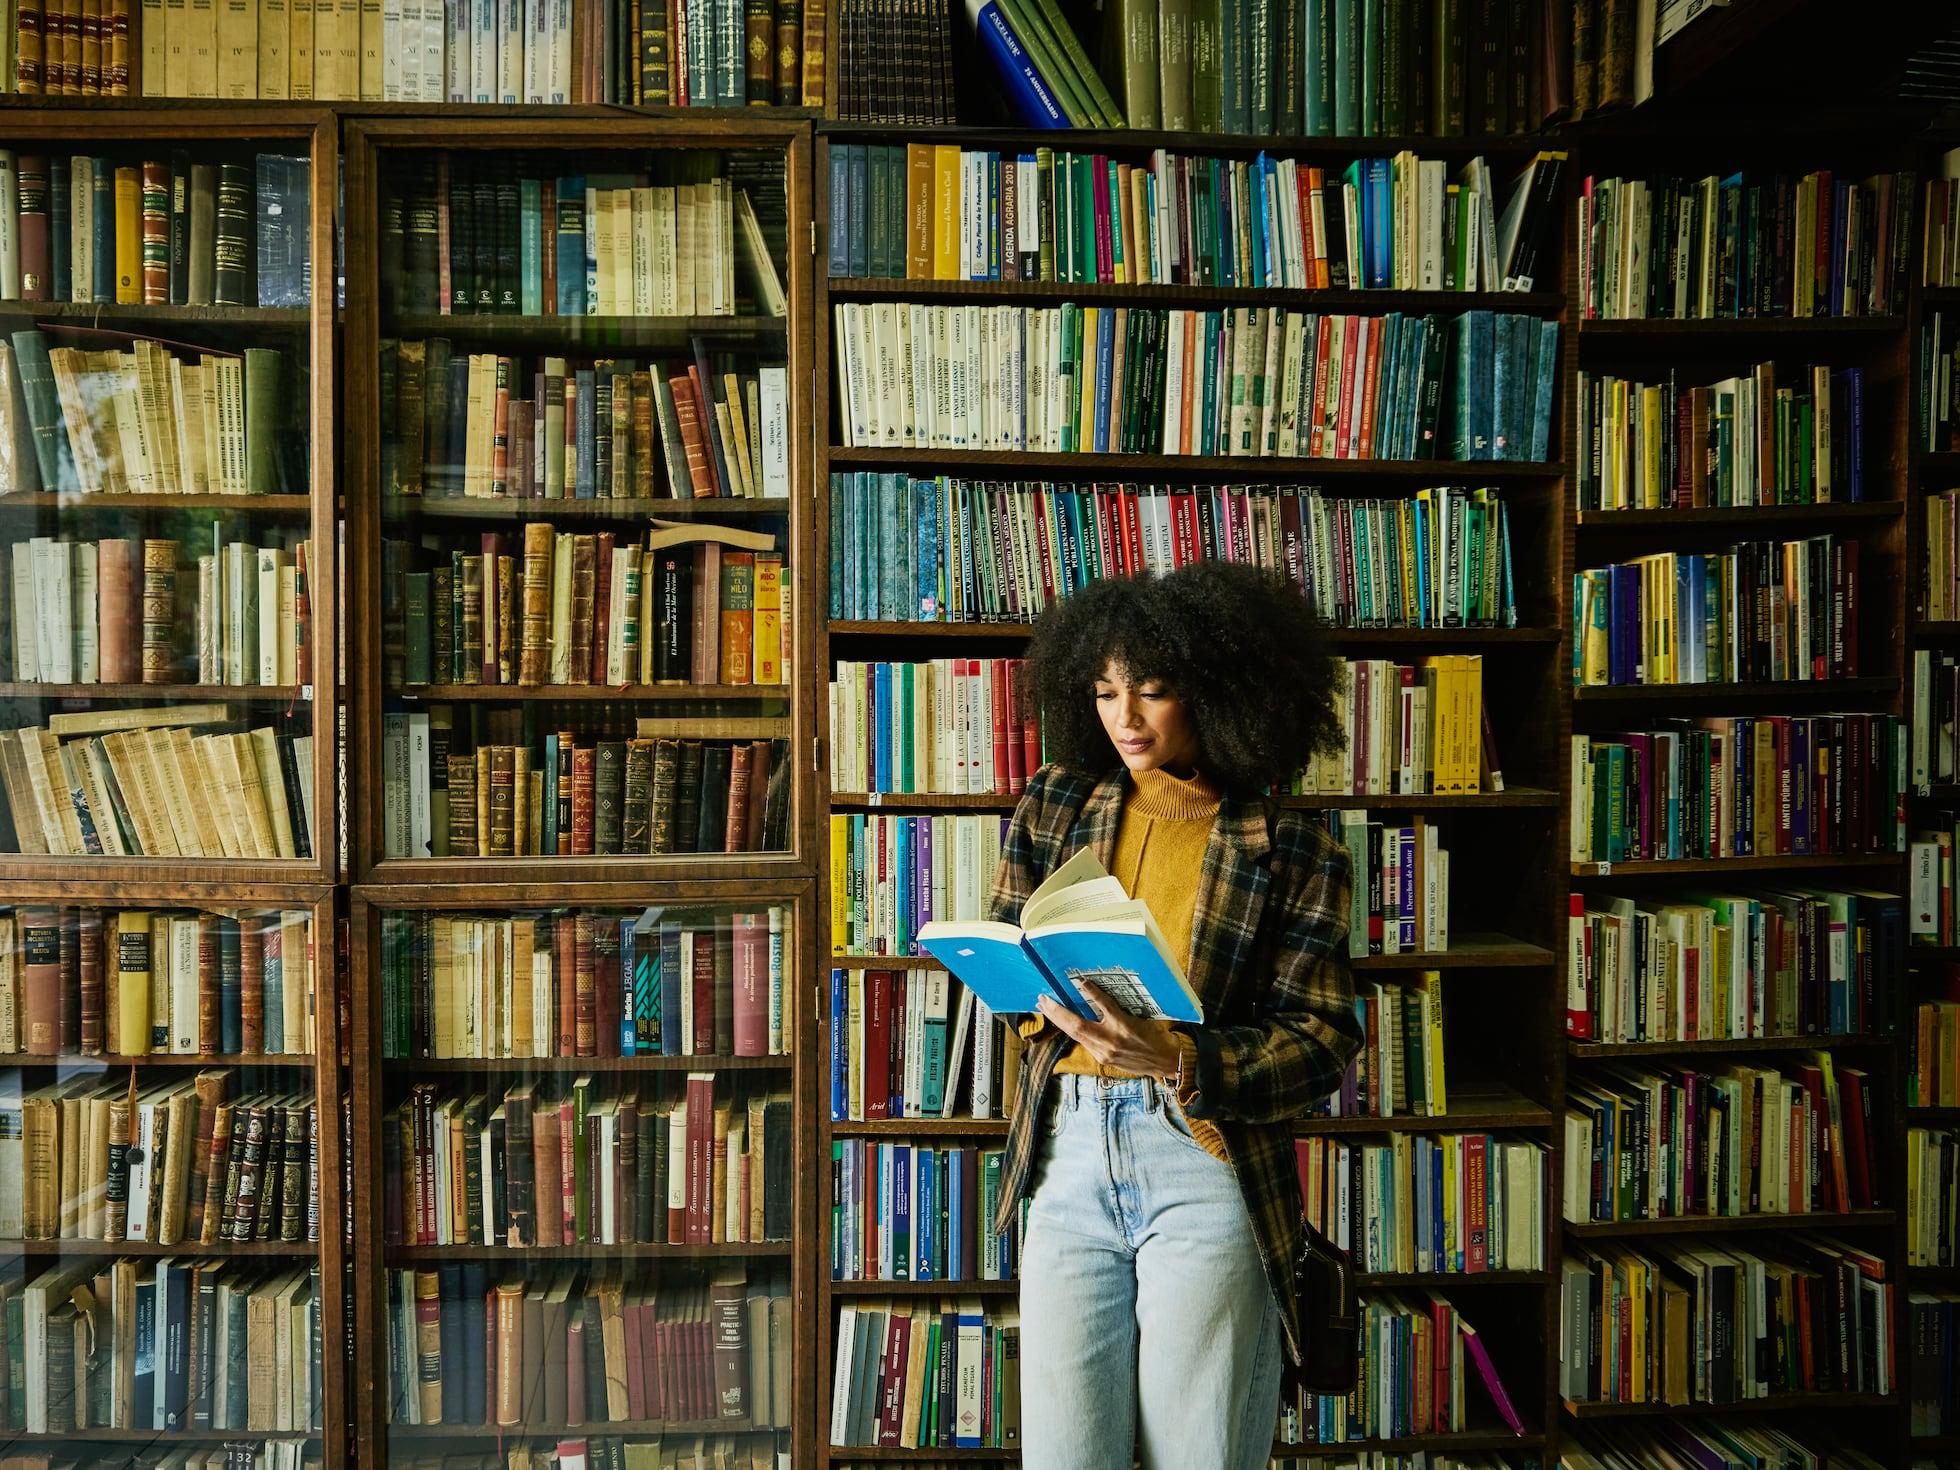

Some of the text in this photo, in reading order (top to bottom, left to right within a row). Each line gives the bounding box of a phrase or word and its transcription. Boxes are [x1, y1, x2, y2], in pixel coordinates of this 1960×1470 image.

[320, 49, 331, 57] VII
[367, 50, 376, 58] IX
[1030, 77, 1058, 119] ANIVERSARIO
[1005, 186, 1014, 225] AGRARIA
[1006, 227, 1014, 264] AGENDA
[1250, 315, 1256, 324] 5
[1039, 517, 1047, 550] EXCLUSIÓN
[1184, 499, 1192, 538] CONSUMIDOR
[1059, 505, 1070, 563] INTERNACIONAL
[992, 508, 1006, 596] INVERSIÓN EXTRANJERA
[1070, 536, 1078, 568] PÚBLICO
[1288, 532, 1298, 580] ARBITRAJE
[1043, 558, 1051, 587] DIGNIDAD
[731, 585, 747, 593] NILO
[973, 746, 979, 754] LA
[986, 741, 991, 749] LA
[404, 779, 410, 789] DE
[1780, 769, 1791, 829] MANTO PÚRPURA
[1611, 800, 1621, 838] JEFATURA
[1407, 870, 1413, 878] de
[1406, 880, 1414, 910] Derechos
[624, 959, 632, 990] LEGAL
[414, 1097, 418, 1105] 1
[424, 1095, 431, 1104] 2
[1354, 1166, 1362, 1190] MÉXICO
[690, 1177, 698, 1215] TESTIMONIOS
[703, 1178, 711, 1215] TESTIMONIOS
[1355, 1191, 1362, 1199] EN
